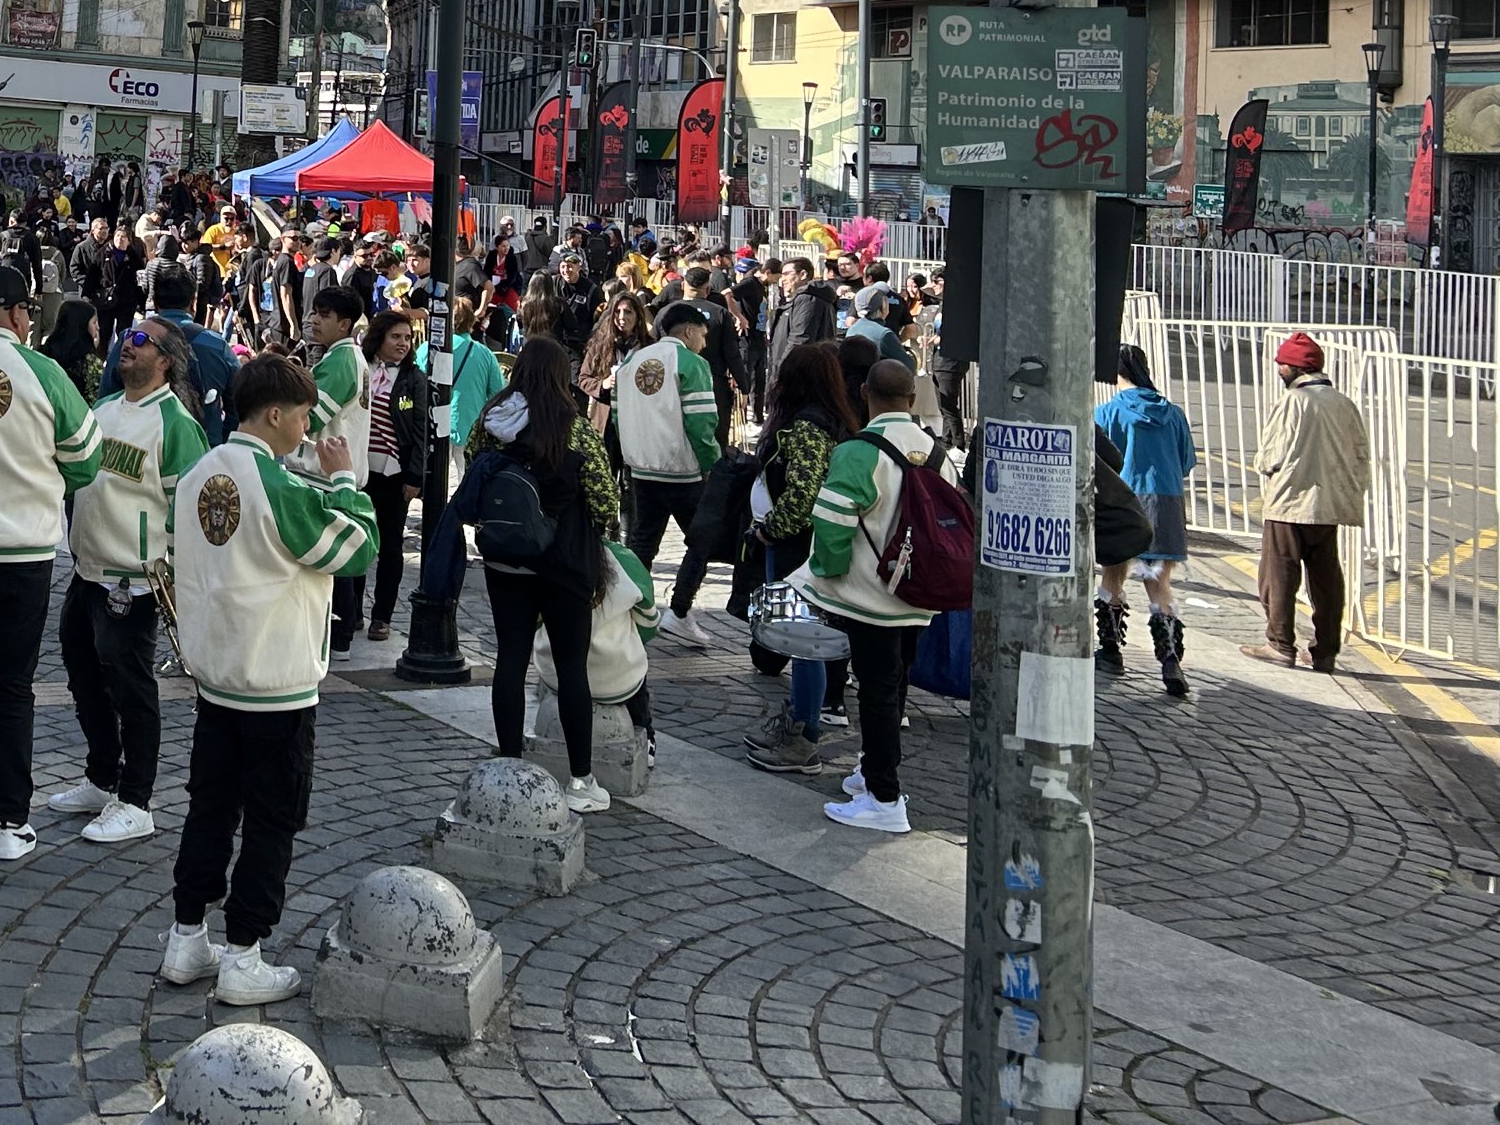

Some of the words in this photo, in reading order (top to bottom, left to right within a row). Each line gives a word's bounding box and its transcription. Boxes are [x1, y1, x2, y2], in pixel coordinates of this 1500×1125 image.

[945, 23, 967, 38] RP
[979, 21, 1005, 29] RUTA
[979, 33, 1046, 43] PATRIMONIAL
[1077, 24, 1112, 46] gtd
[1077, 51, 1121, 59] CAERAN
[938, 64, 1052, 81] VALPARAISO
[1077, 72, 1121, 80] CAERAN
[123, 80, 160, 97] ECO
[121, 96, 159, 106] Farmacias
[938, 92, 1037, 109] Patrimonio
[1041, 95, 1064, 109] de
[1069, 96, 1085, 110] la
[938, 112, 1040, 130] Humanidad
[995, 425, 1056, 452] TAROT
[1002, 451, 1070, 466] MARGARITA
[995, 511, 1031, 553] 2682
[1034, 516, 1071, 556] 6266
